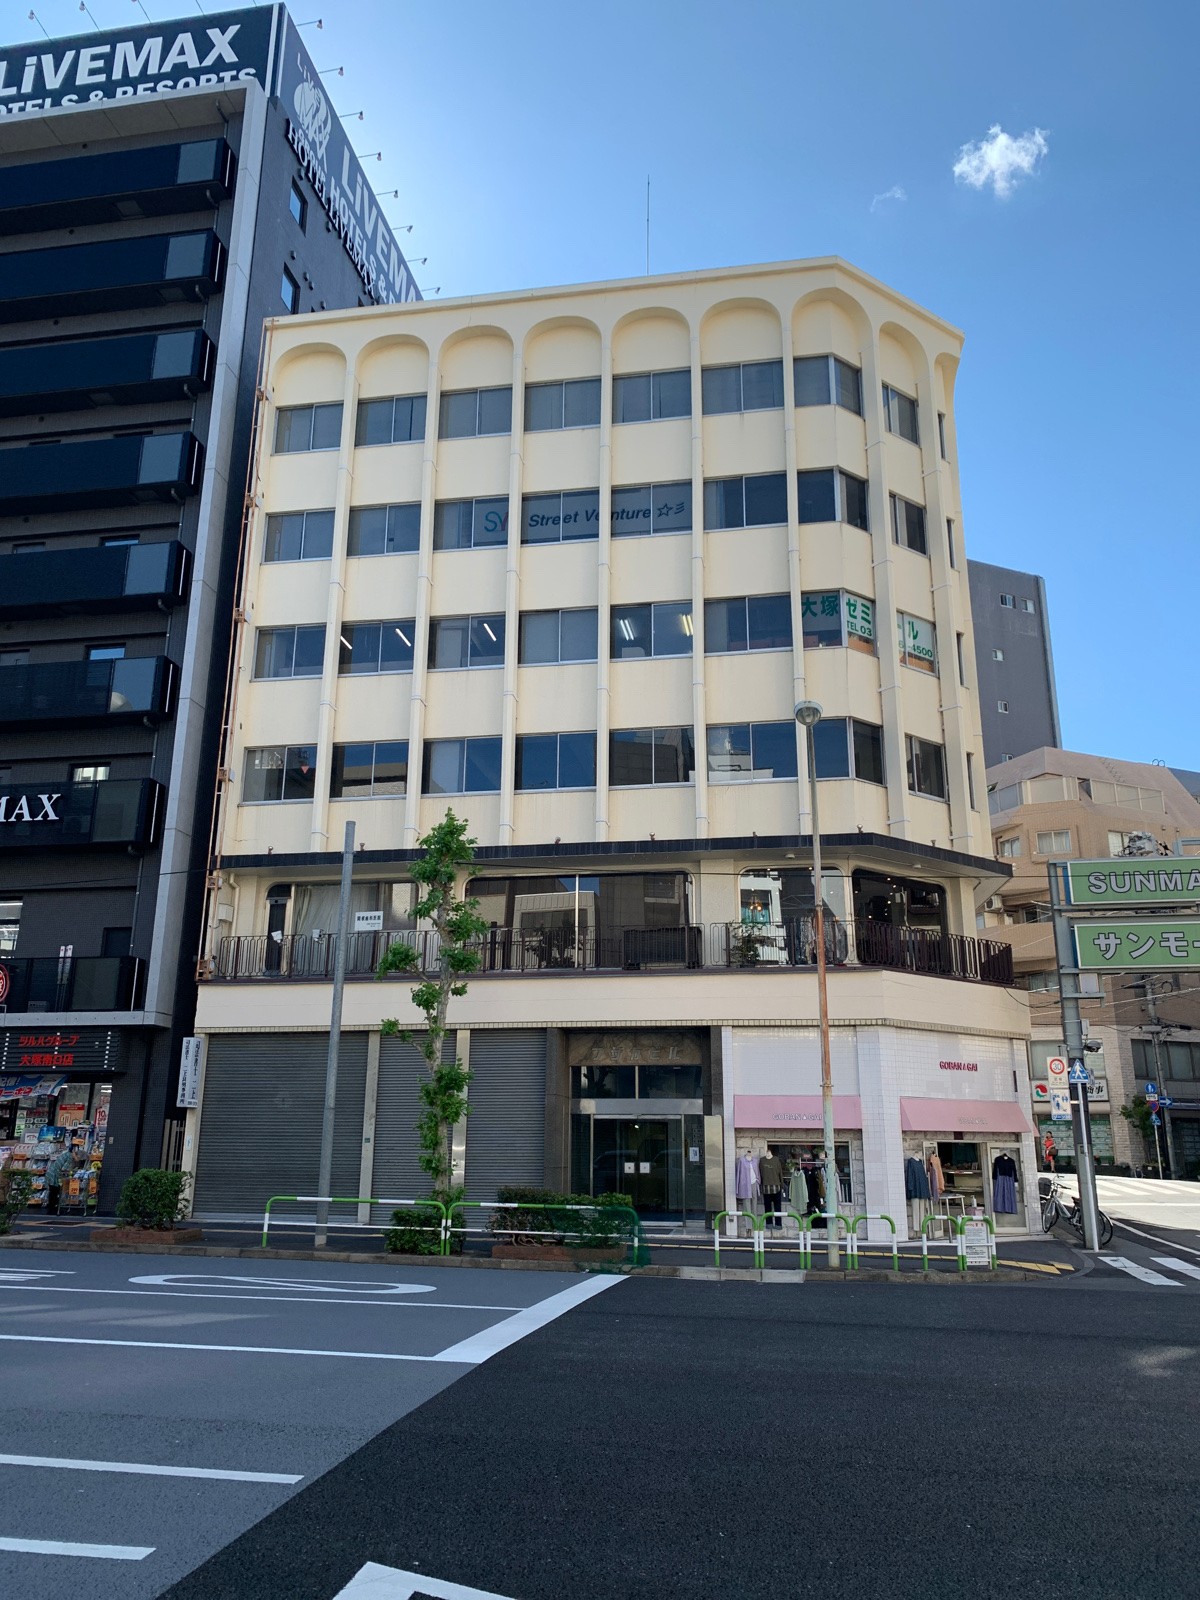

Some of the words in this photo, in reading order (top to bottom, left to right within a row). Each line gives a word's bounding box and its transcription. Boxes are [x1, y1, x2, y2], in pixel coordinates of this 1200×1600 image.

[528, 510, 579, 528] Street
[860, 625, 872, 637] 03
[1052, 1062, 1062, 1071] 30
